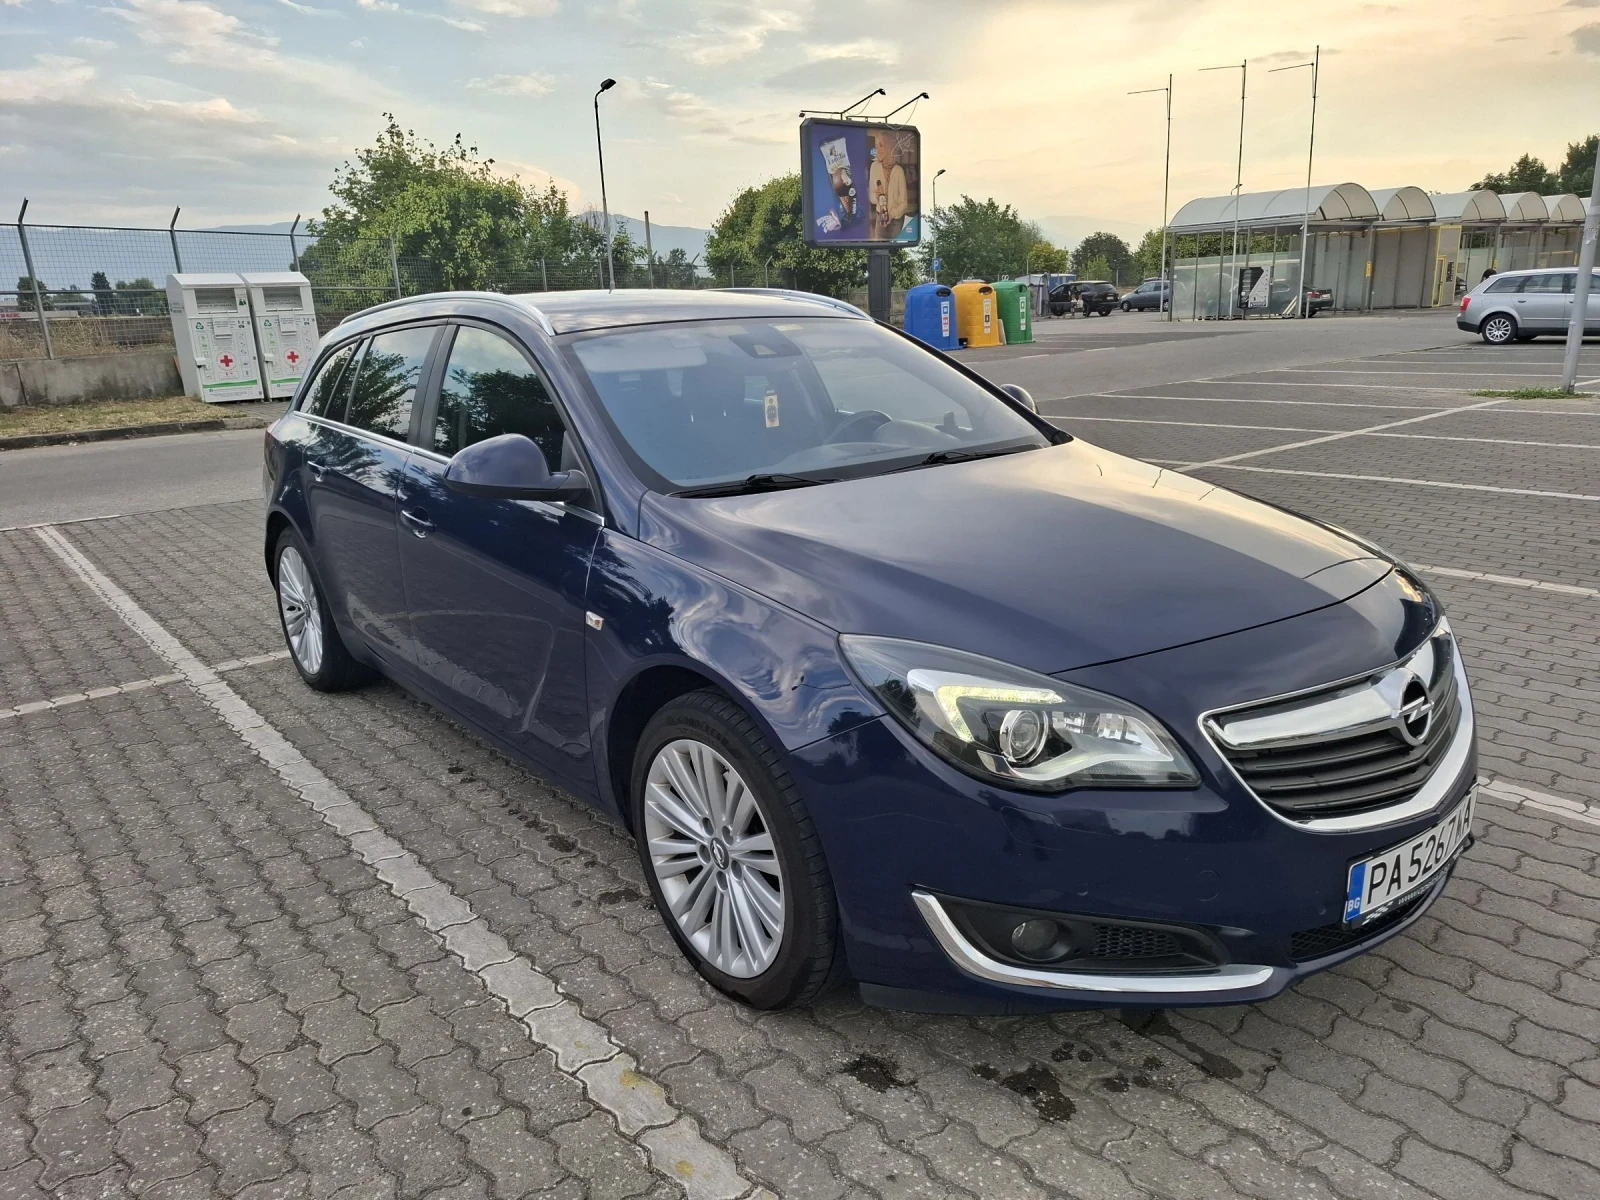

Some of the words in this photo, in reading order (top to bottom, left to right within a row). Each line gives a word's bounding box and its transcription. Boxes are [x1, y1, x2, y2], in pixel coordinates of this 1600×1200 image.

[1366, 853, 1402, 905] PA
[1407, 815, 1457, 883] 5267
[1348, 896, 1361, 912] BG
